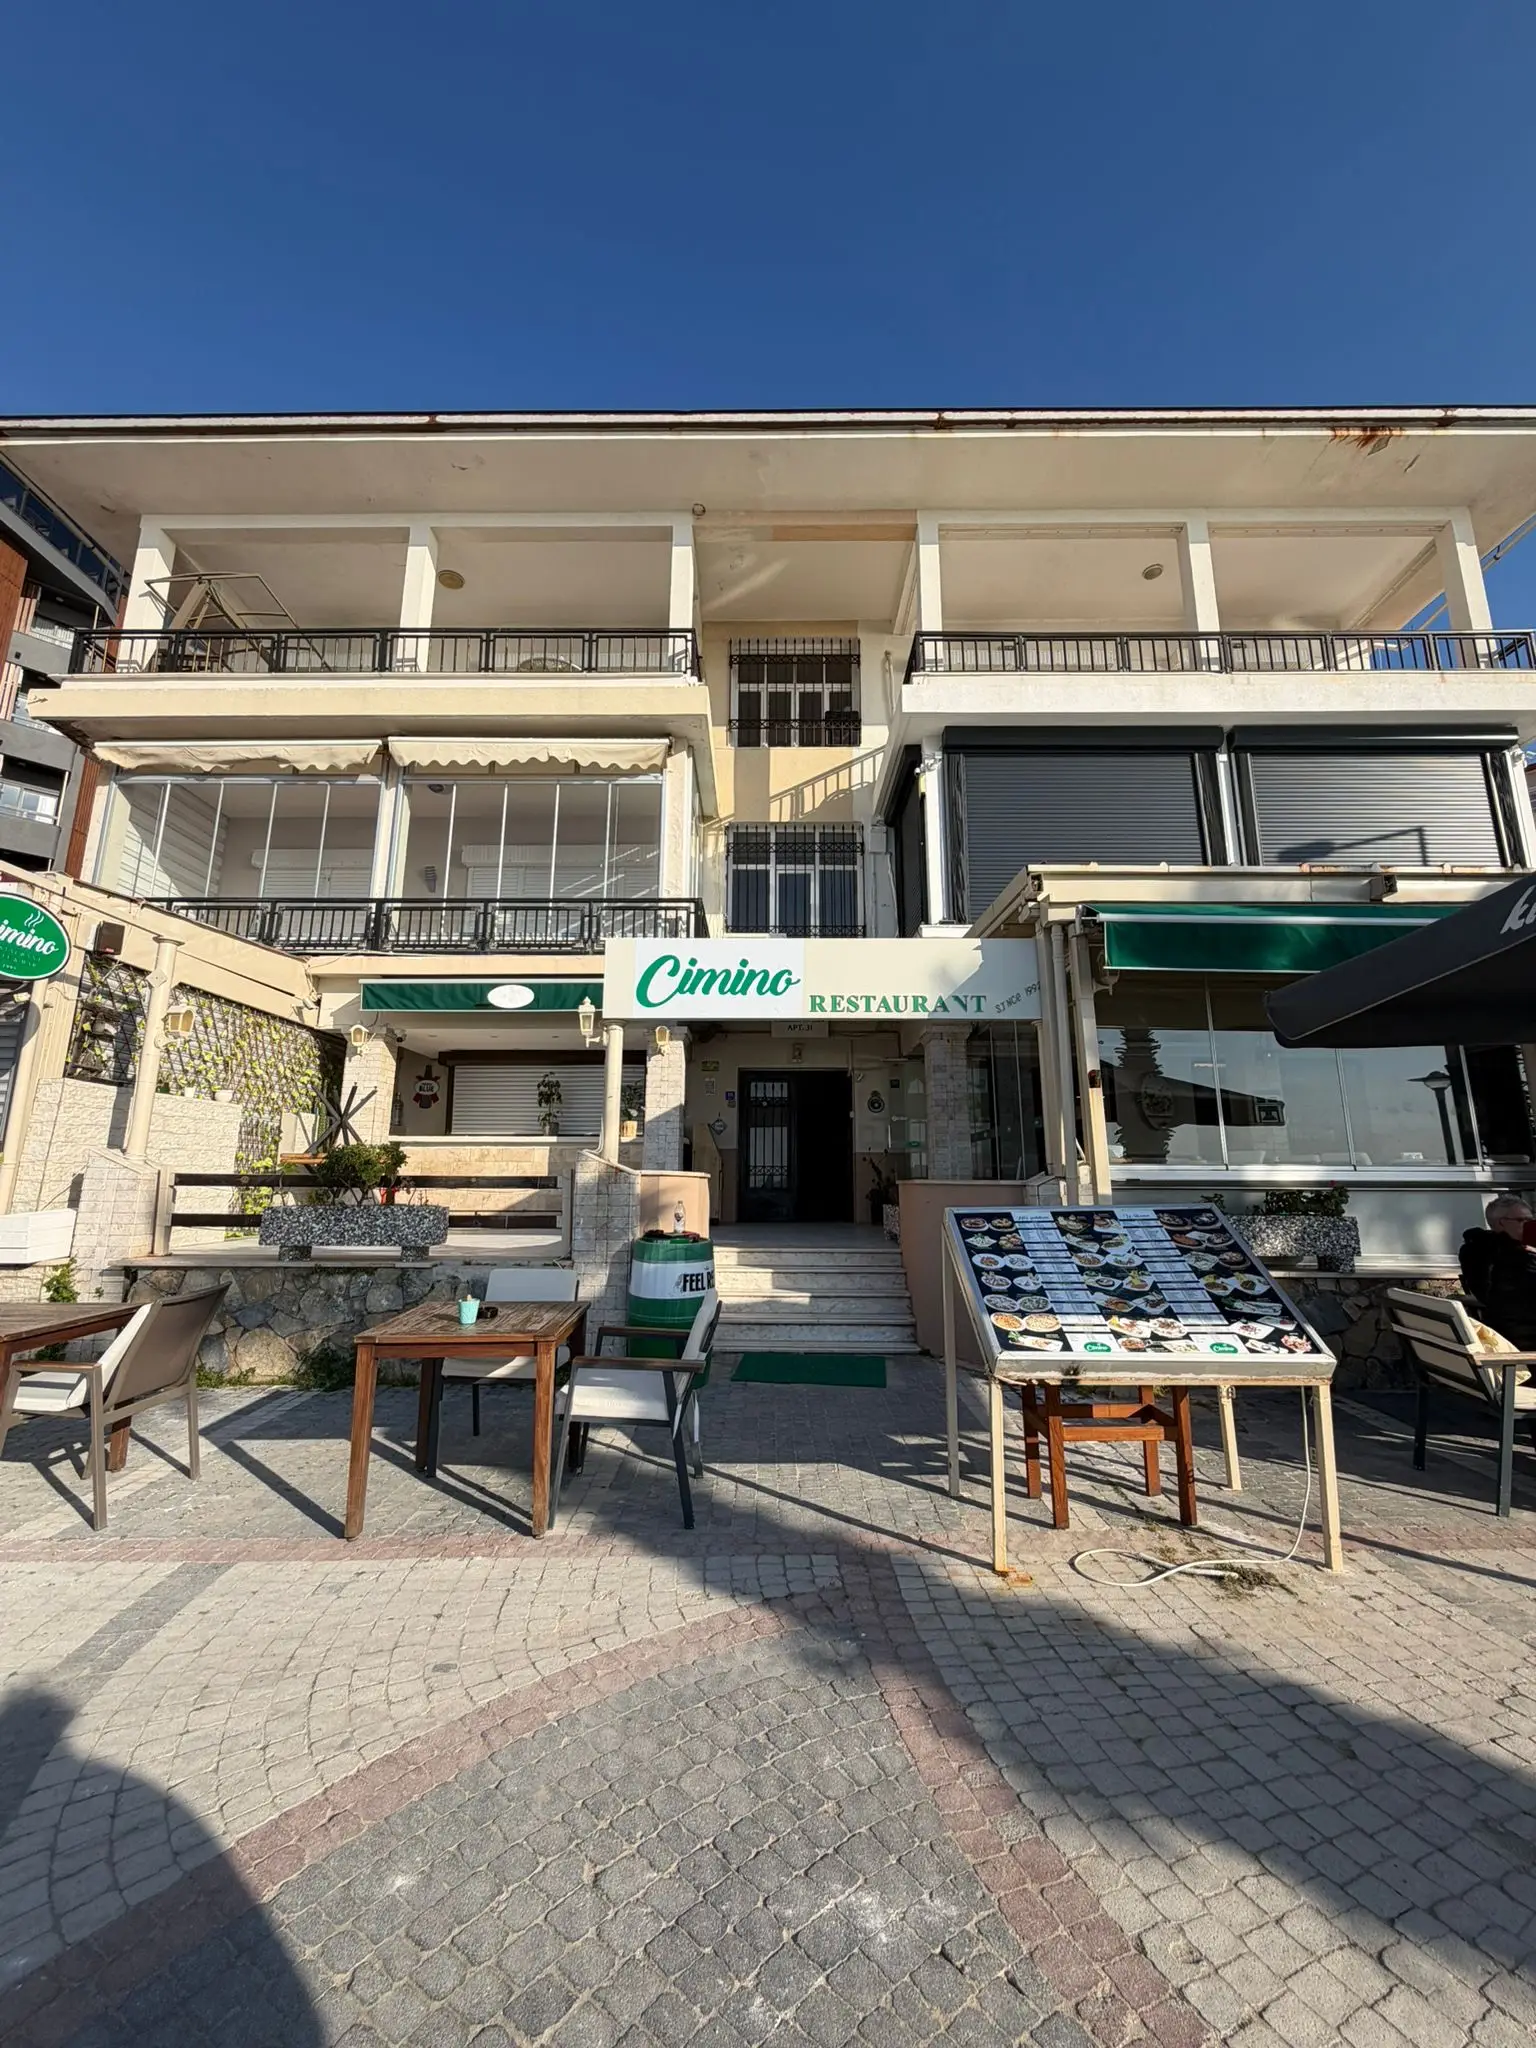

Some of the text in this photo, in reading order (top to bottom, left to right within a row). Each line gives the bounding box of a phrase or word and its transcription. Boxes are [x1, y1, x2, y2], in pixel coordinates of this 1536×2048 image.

[0, 919, 59, 955] imino
[636, 954, 801, 1008] Cimino
[809, 994, 986, 1013] RESTAURANT
[682, 1272, 705, 1291] FEEL
